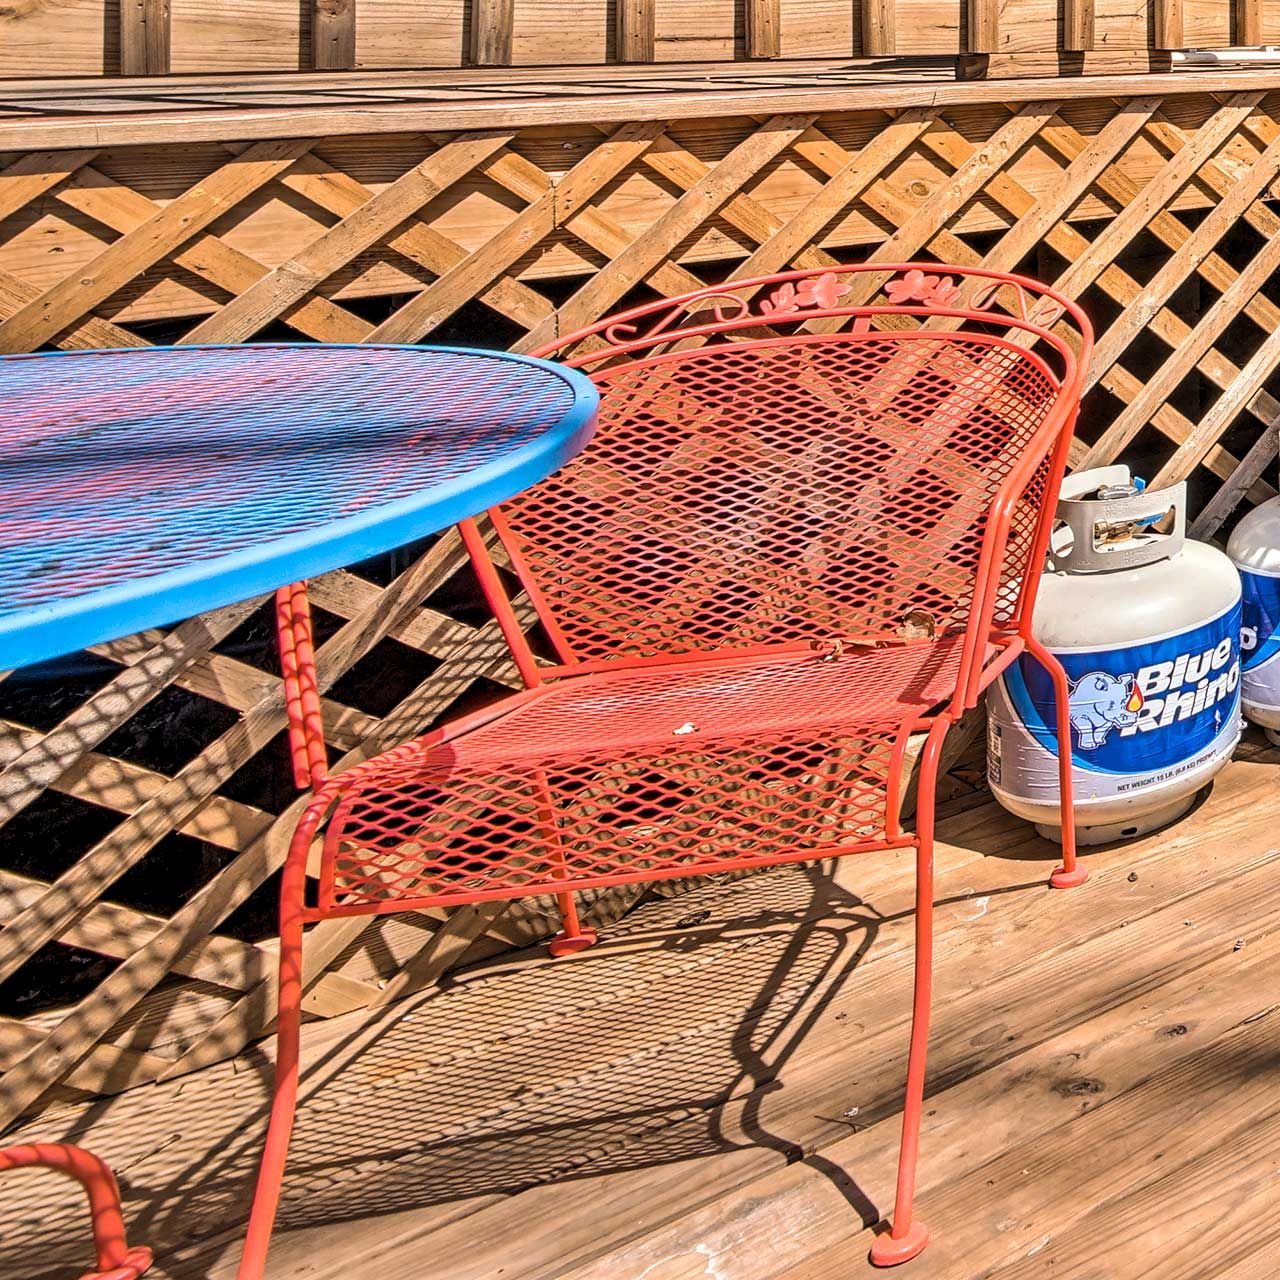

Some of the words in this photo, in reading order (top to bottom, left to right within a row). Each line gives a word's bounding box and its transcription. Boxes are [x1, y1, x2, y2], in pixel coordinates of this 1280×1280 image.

[1136, 637, 1232, 696] Blue
[1120, 660, 1240, 737] Rhino
[1117, 783, 1130, 792] NET
[1131, 776, 1155, 788] WEIGHT
